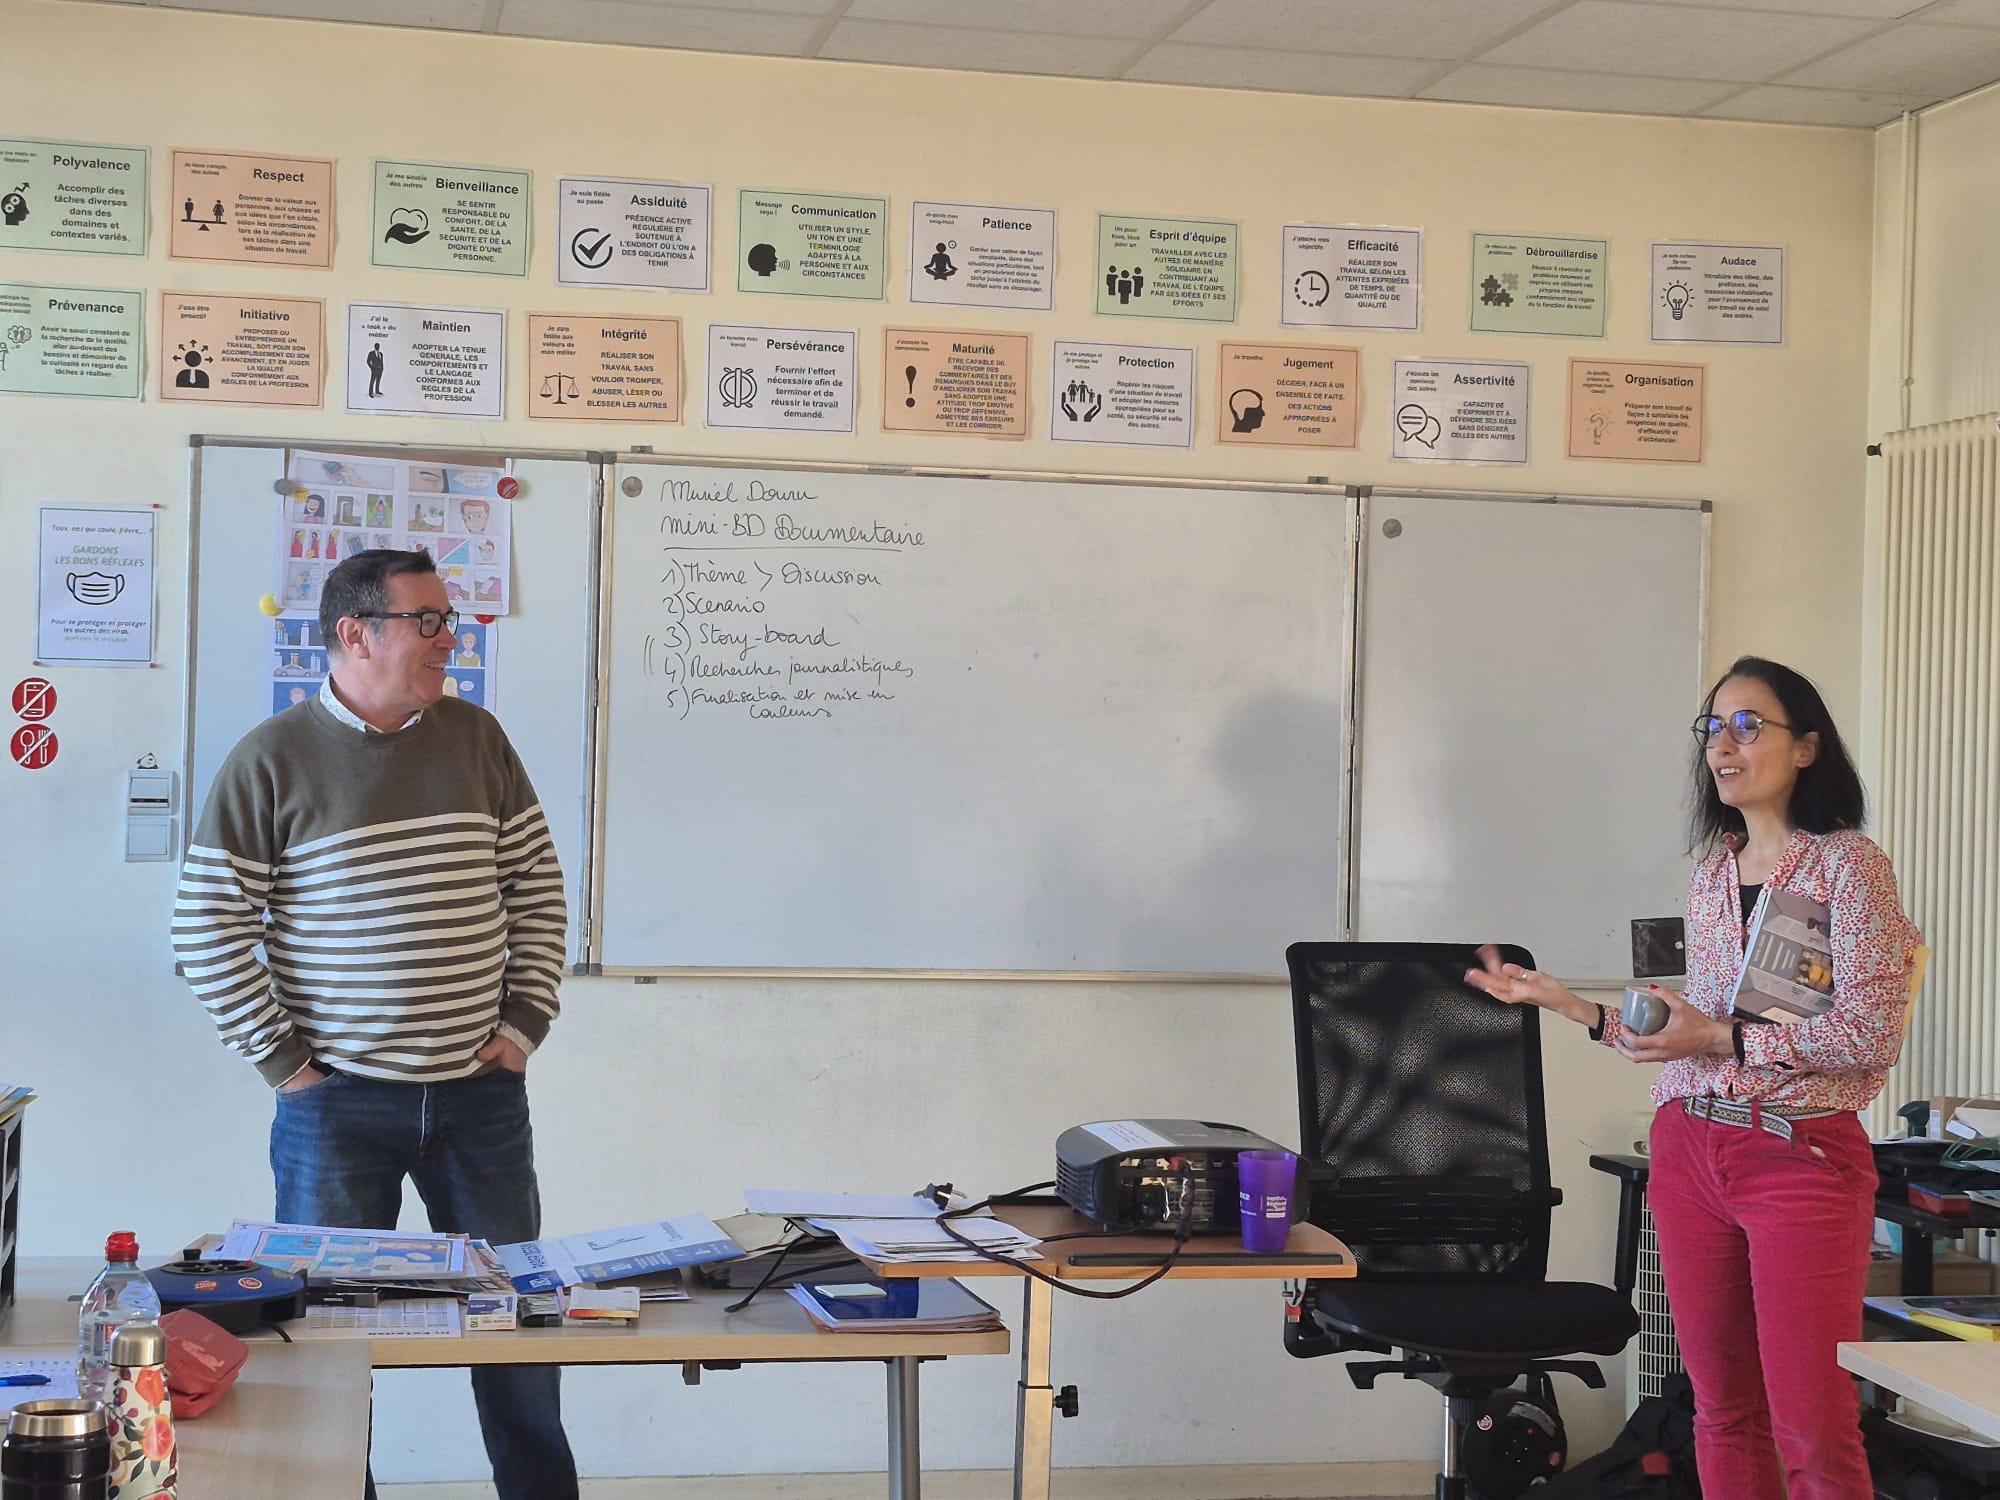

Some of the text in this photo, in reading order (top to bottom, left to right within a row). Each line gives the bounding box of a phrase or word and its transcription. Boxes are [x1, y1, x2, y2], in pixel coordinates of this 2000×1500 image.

[53, 155, 131, 171] Polyvalence
[254, 168, 304, 182] Respect
[58, 184, 125, 195] Accomplir des
[436, 178, 518, 194] Bienveillance
[55, 195, 128, 206] tâches diverses
[469, 201, 496, 209] SENTIR
[631, 194, 687, 208] Assiduité
[70, 208, 112, 217] dans des
[442, 208, 497, 218] RESPONSABLE
[792, 204, 876, 220] Communication
[62, 218, 107, 228] domaines
[625, 214, 692, 225] PRÉSENCE ACTIVE
[982, 217, 1032, 231] Patience
[799, 224, 832, 232] UTILISER
[51, 230, 96, 239] contextes
[635, 233, 674, 241] SOUTENUE
[1149, 230, 1227, 244] Esprit d'équipe
[1348, 240, 1399, 252] Efficacité
[638, 250, 687, 260] OBLIGATIONS
[1526, 247, 1598, 260] Débrouillardise
[800, 260, 840, 269] PERSONNE
[1721, 257, 1756, 266] Audace
[802, 270, 865, 280] CIRCONSTANCES
[49, 299, 124, 314] Prévenance
[240, 309, 290, 321] Initiative
[423, 320, 470, 332] Maintien
[602, 329, 647, 341] Intégrité
[412, 344, 447, 352] ADOPTER
[766, 339, 845, 353] Persévérance
[952, 344, 995, 355] Maturité
[409, 360, 477, 370] COMPORTEMENTS
[1118, 356, 1174, 369] Protection
[1283, 358, 1334, 369] Jugement
[775, 366, 806, 374] Fournir
[416, 377, 463, 385] CONFORMES
[767, 377, 813, 385] nécessaire
[1453, 374, 1515, 386] Assertivité
[1625, 374, 1694, 387] Organisation
[424, 393, 472, 401] PROFESSION
[776, 388, 810, 396] terminer
[771, 399, 800, 407] réussir
[660, 480, 738, 502] Muriel
[774, 514, 926, 546] Documentaire
[73, 546, 119, 554] GARDONS
[102, 557, 144, 566] RÉFLEXES
